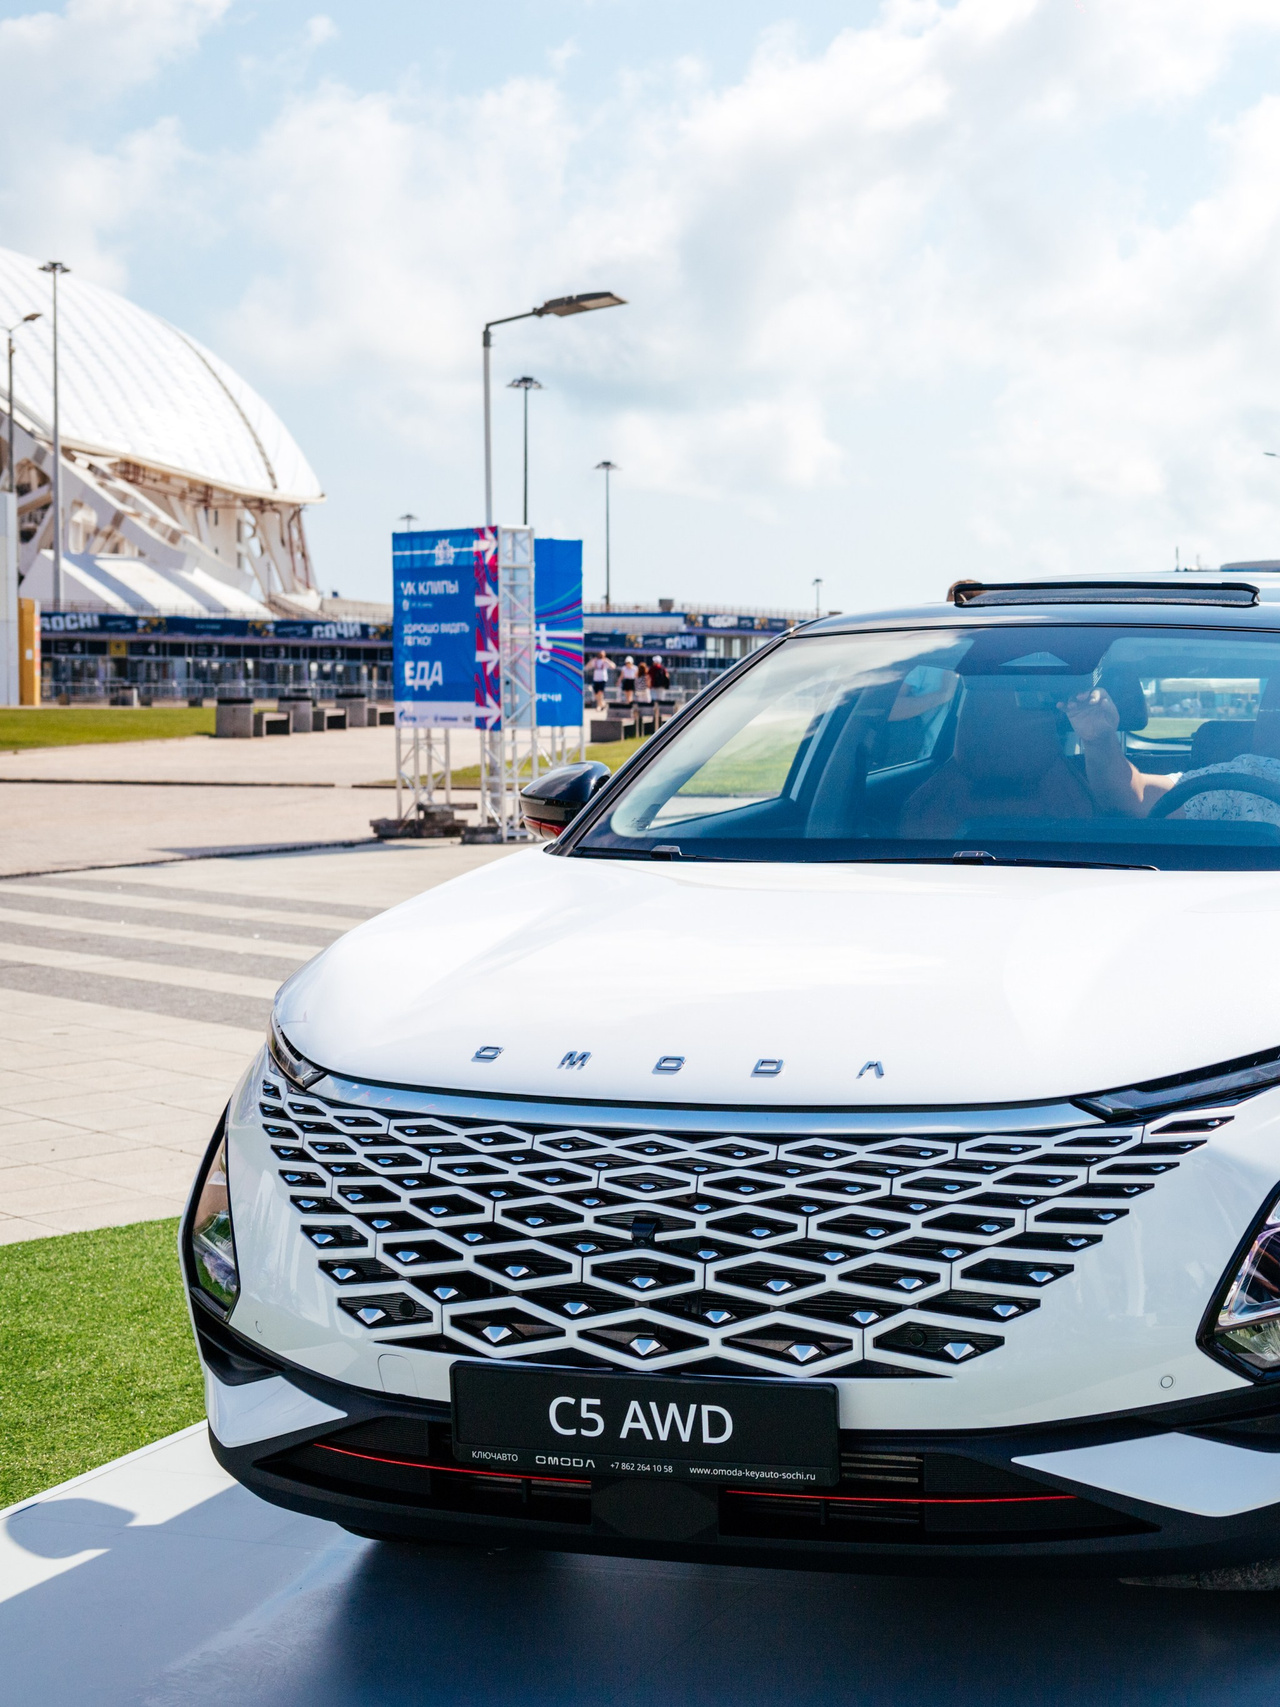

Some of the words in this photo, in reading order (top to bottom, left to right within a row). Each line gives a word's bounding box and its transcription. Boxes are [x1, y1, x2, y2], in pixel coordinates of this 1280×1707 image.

[404, 661, 443, 691] ЕДА
[548, 1396, 605, 1438] C5
[619, 1400, 734, 1444] AWD
[471, 1450, 519, 1462] КЛЮЧАВТО
[610, 1462, 619, 1470] +7
[621, 1462, 635, 1471] 862
[636, 1463, 651, 1472] 264
[652, 1464, 662, 1473] 10
[663, 1465, 673, 1473] 58
[689, 1466, 816, 1481] www.omoda-keyauto-sochi.ru
